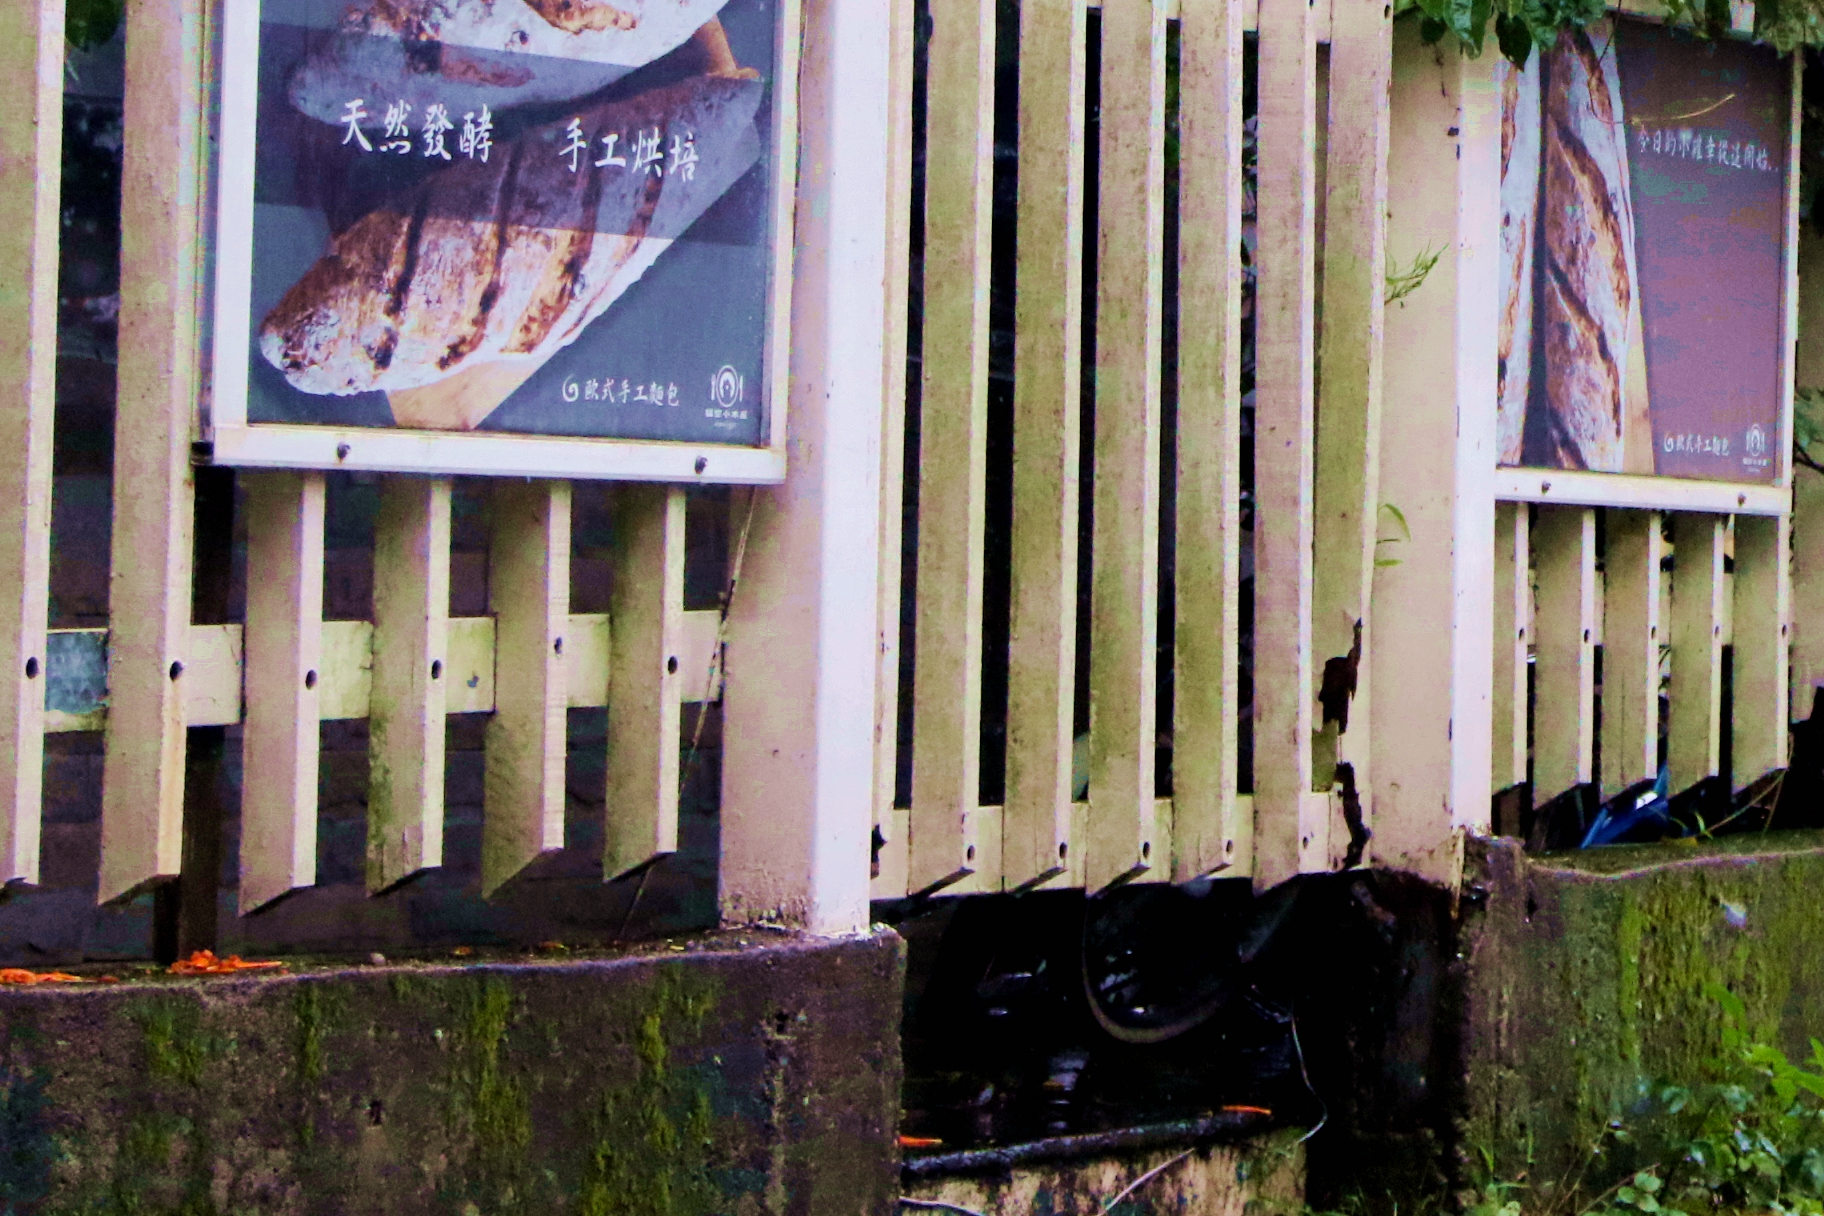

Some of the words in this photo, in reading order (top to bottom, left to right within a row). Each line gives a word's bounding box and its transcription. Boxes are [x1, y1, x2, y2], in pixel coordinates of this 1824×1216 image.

[341, 98, 494, 163] 天然發酵
[558, 117, 700, 183] 手工烘培
[584, 378, 680, 407] 歐式手工麵包
